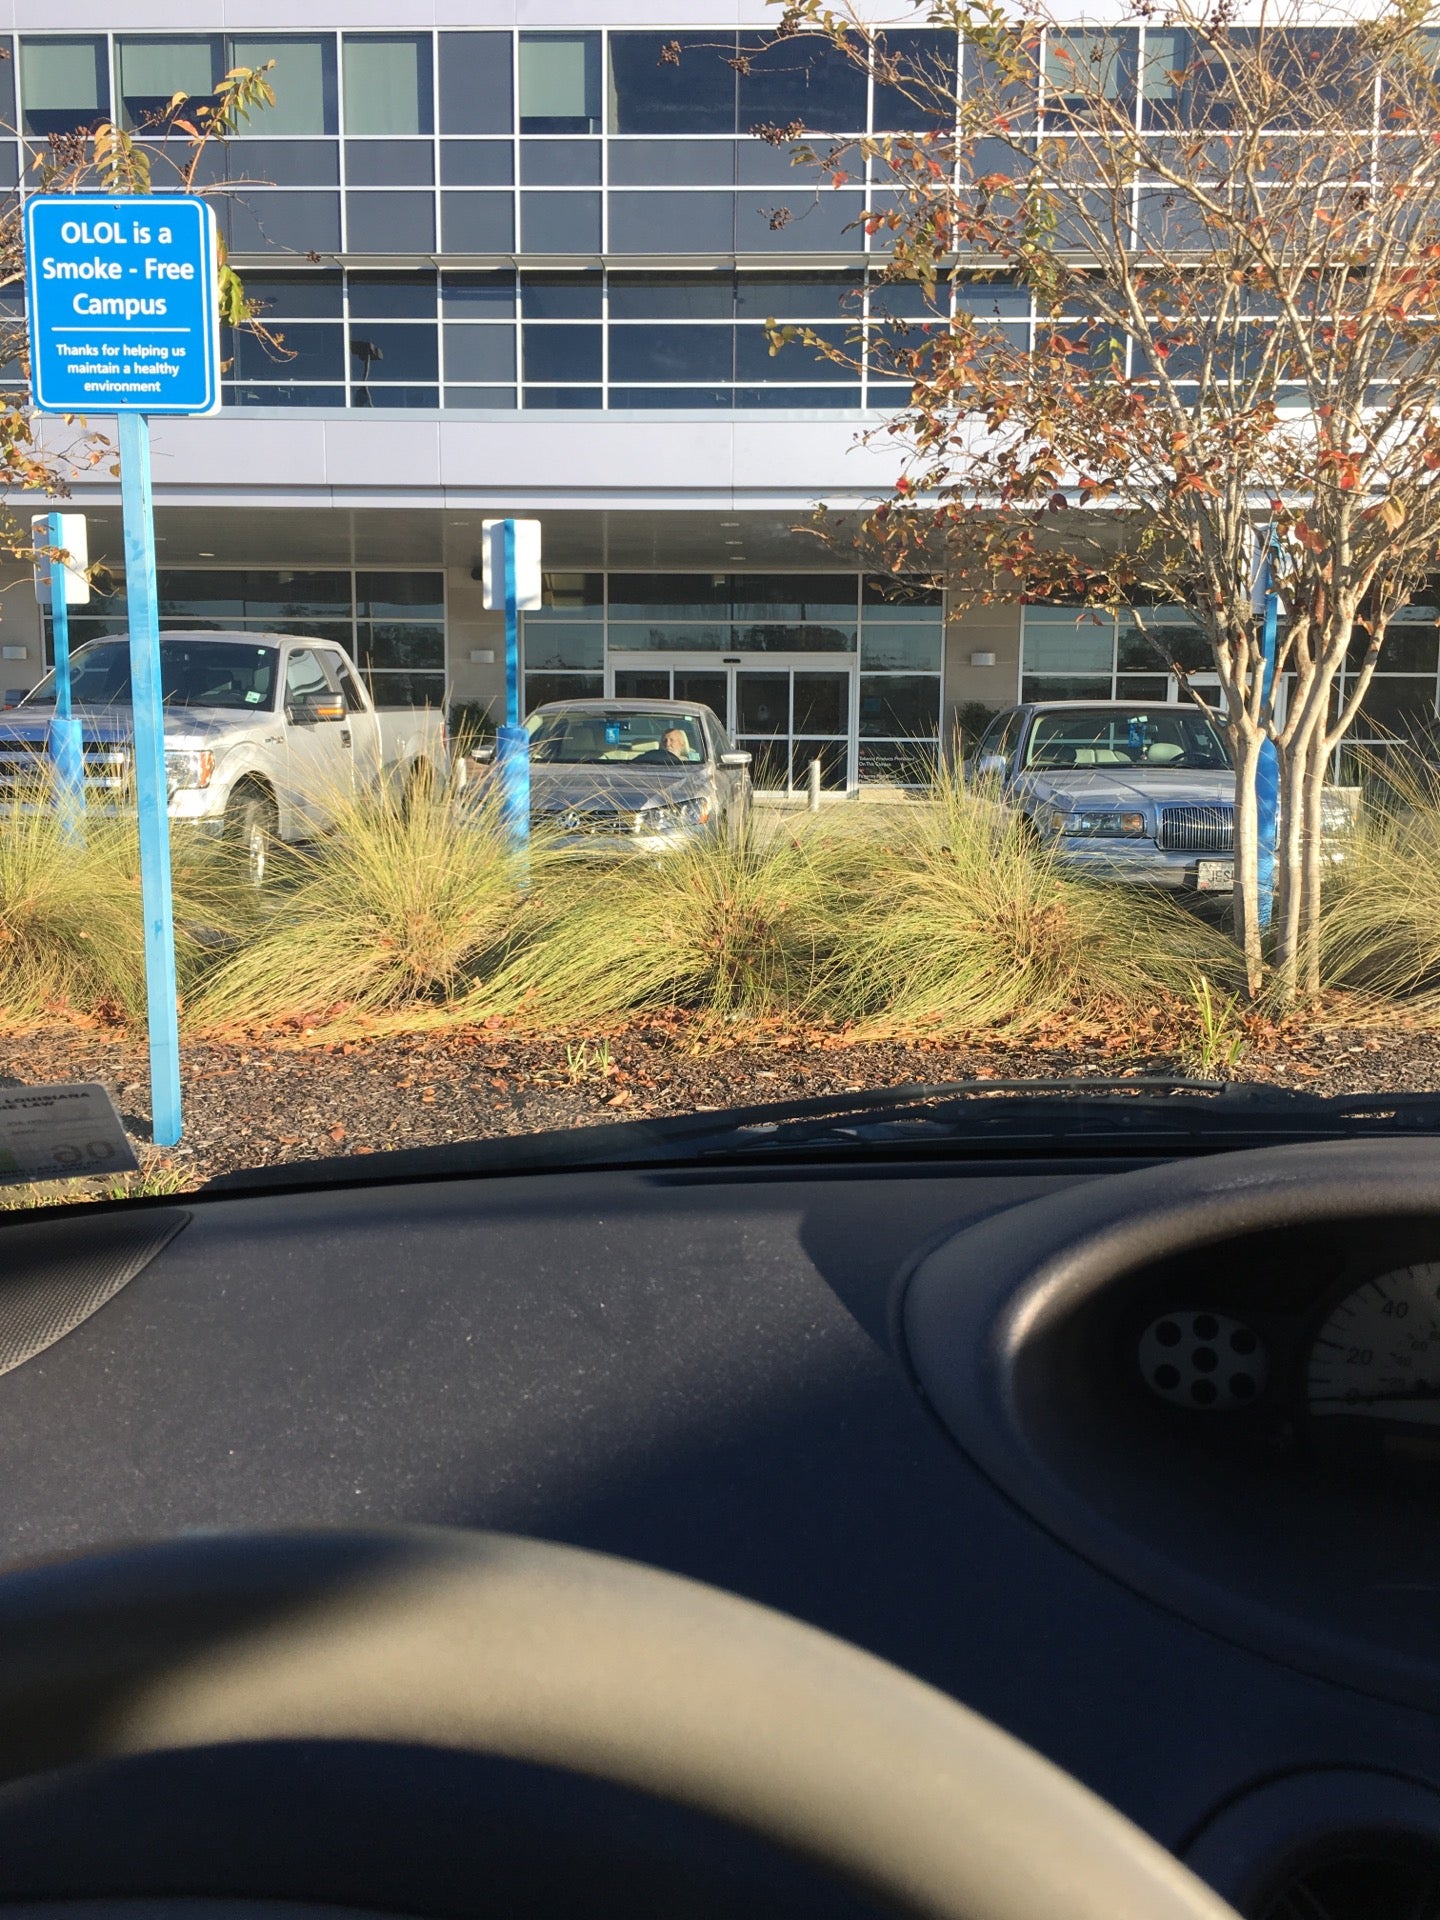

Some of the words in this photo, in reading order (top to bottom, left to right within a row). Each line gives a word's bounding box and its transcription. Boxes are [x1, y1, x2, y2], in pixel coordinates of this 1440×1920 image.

[61, 222, 127, 244] OLOL
[132, 221, 151, 244] is
[157, 226, 172, 244] a
[42, 256, 122, 280] Smoke
[145, 258, 194, 280] Free
[72, 292, 167, 321] Campus
[56, 344, 99, 356] Thanks
[101, 344, 120, 356] for
[123, 344, 169, 359] helping
[172, 346, 186, 357] us
[67, 362, 120, 375] maintain
[123, 365, 131, 375] a
[134, 362, 180, 378] healthy
[84, 380, 162, 393] environment
[1381, 1299, 1410, 1319] 40
[1346, 1347, 1374, 1366] 20
